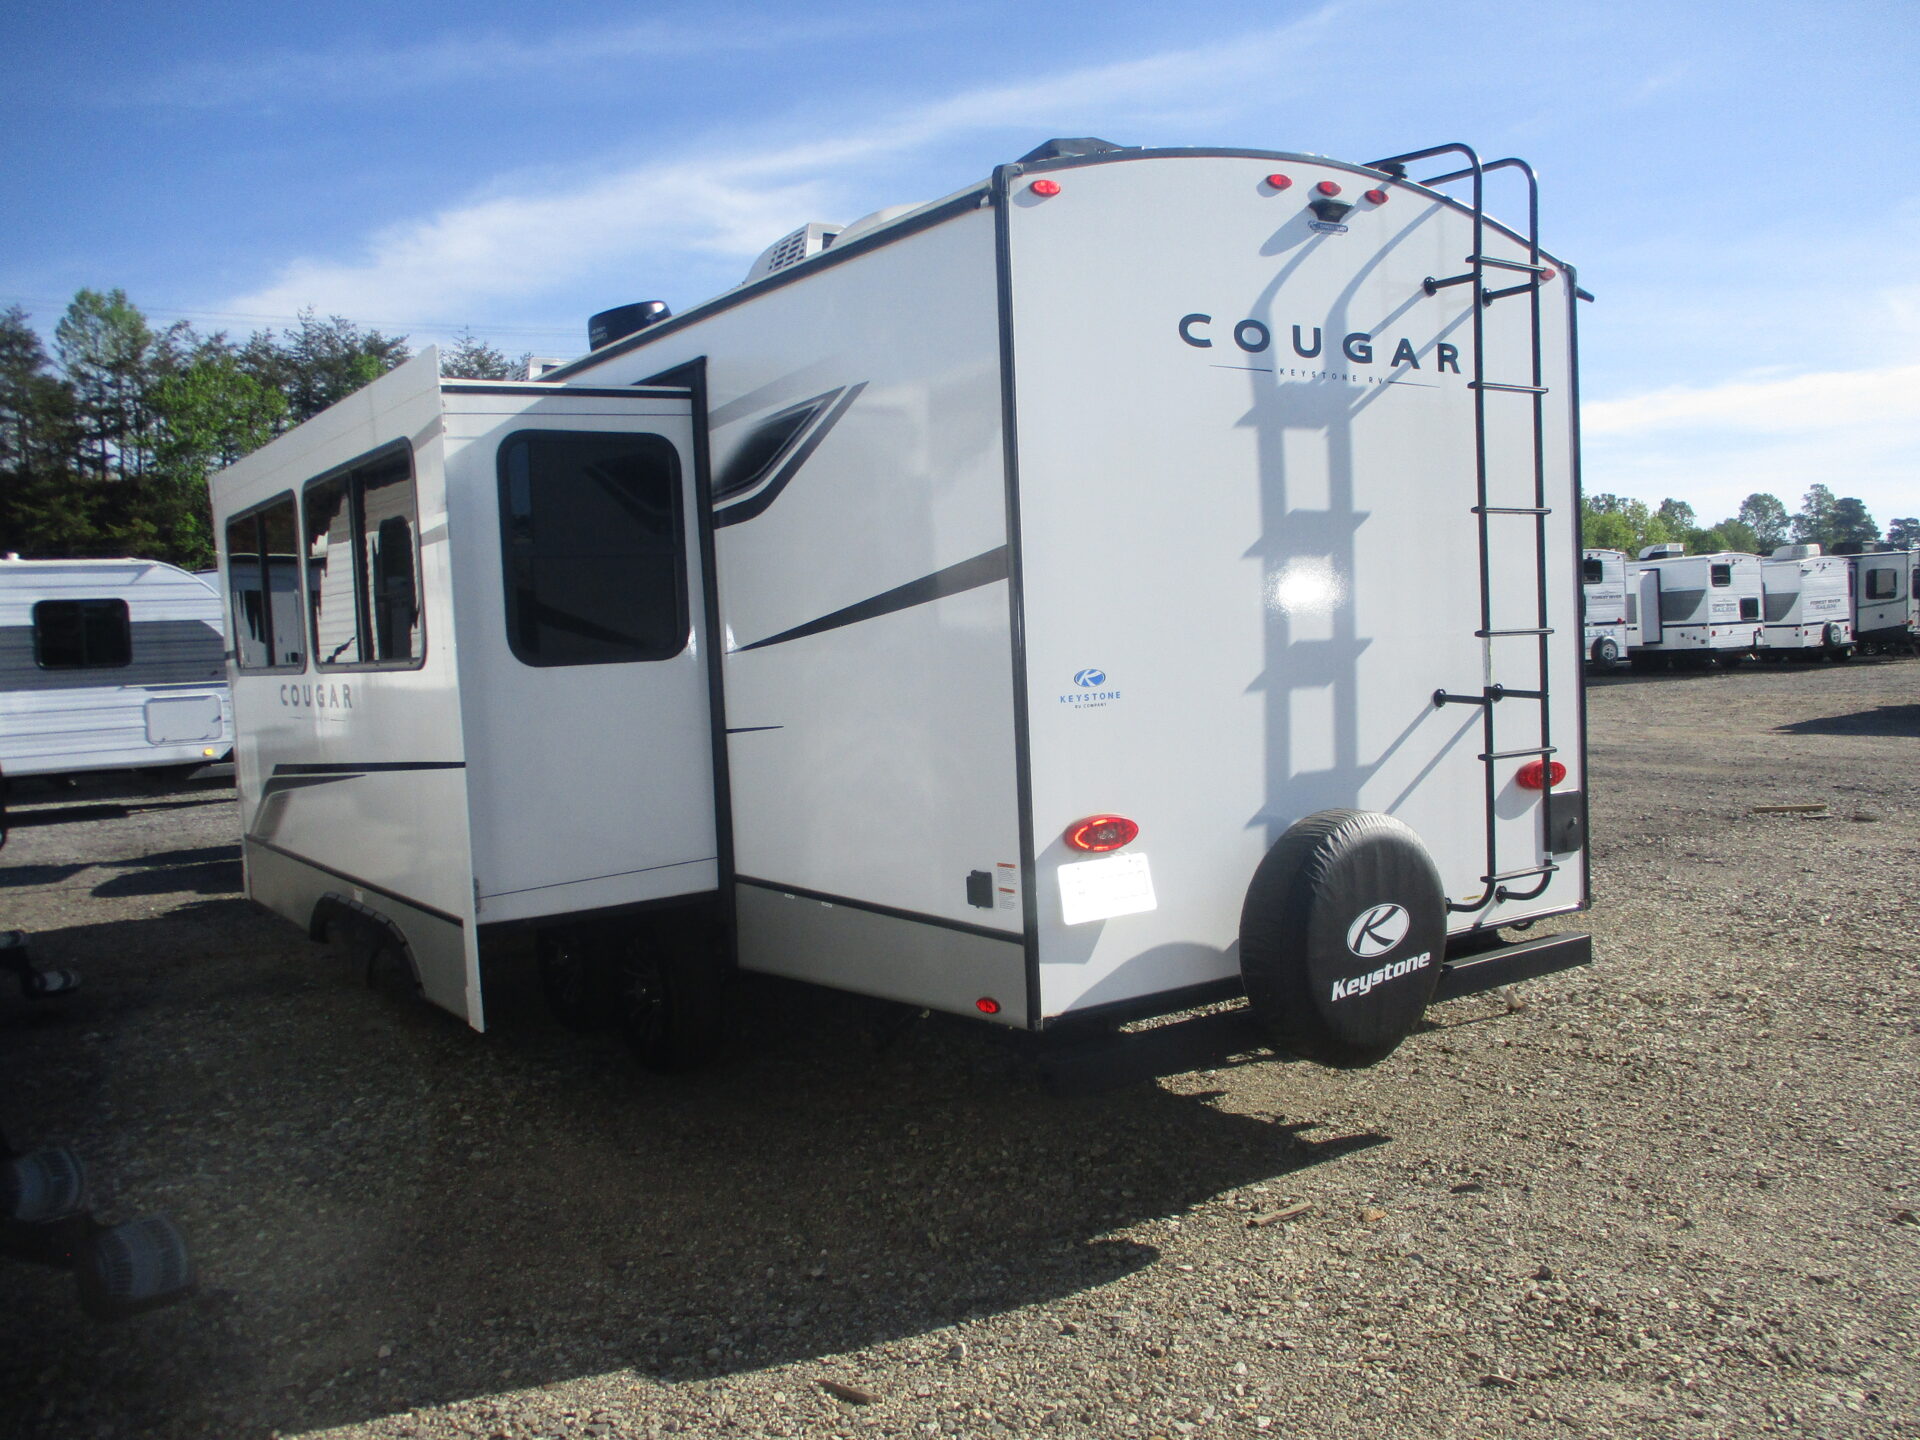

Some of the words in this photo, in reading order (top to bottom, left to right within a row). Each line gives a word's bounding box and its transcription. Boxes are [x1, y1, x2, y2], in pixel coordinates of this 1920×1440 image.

[1178, 313, 1461, 374] COUGAR
[1280, 368, 1357, 382] KEYSTONE
[1368, 376, 1383, 384] RV
[280, 684, 353, 709] COUGAR
[1060, 691, 1121, 703] KEYSTONE
[1331, 952, 1431, 1002] Keystone
